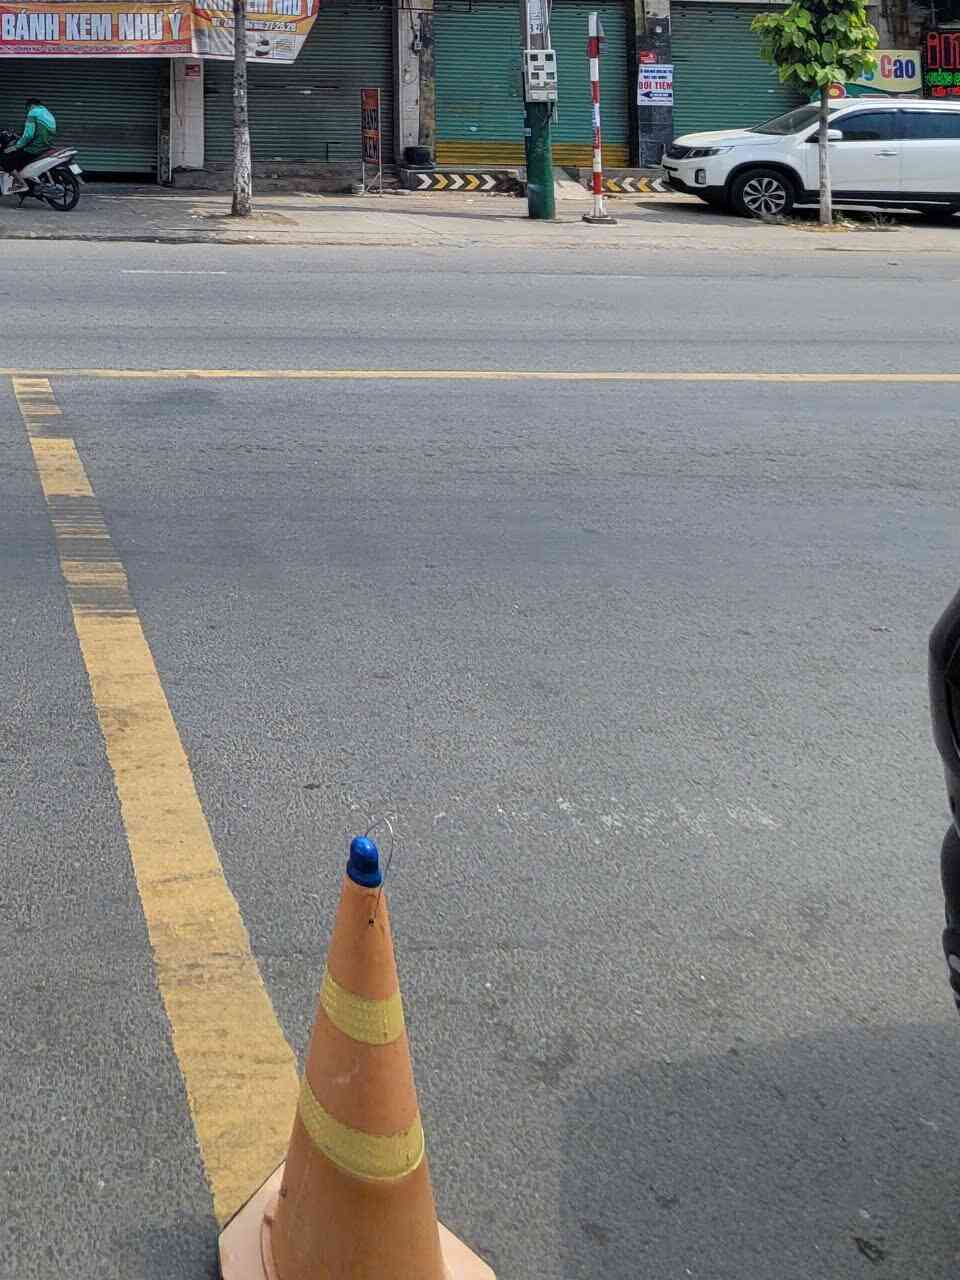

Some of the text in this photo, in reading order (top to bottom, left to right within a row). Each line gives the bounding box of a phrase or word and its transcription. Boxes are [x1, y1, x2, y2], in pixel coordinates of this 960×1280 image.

[1, 8, 184, 41] BÁNH KEM NHƯ Ý
[880, 53, 916, 79] Cáo
